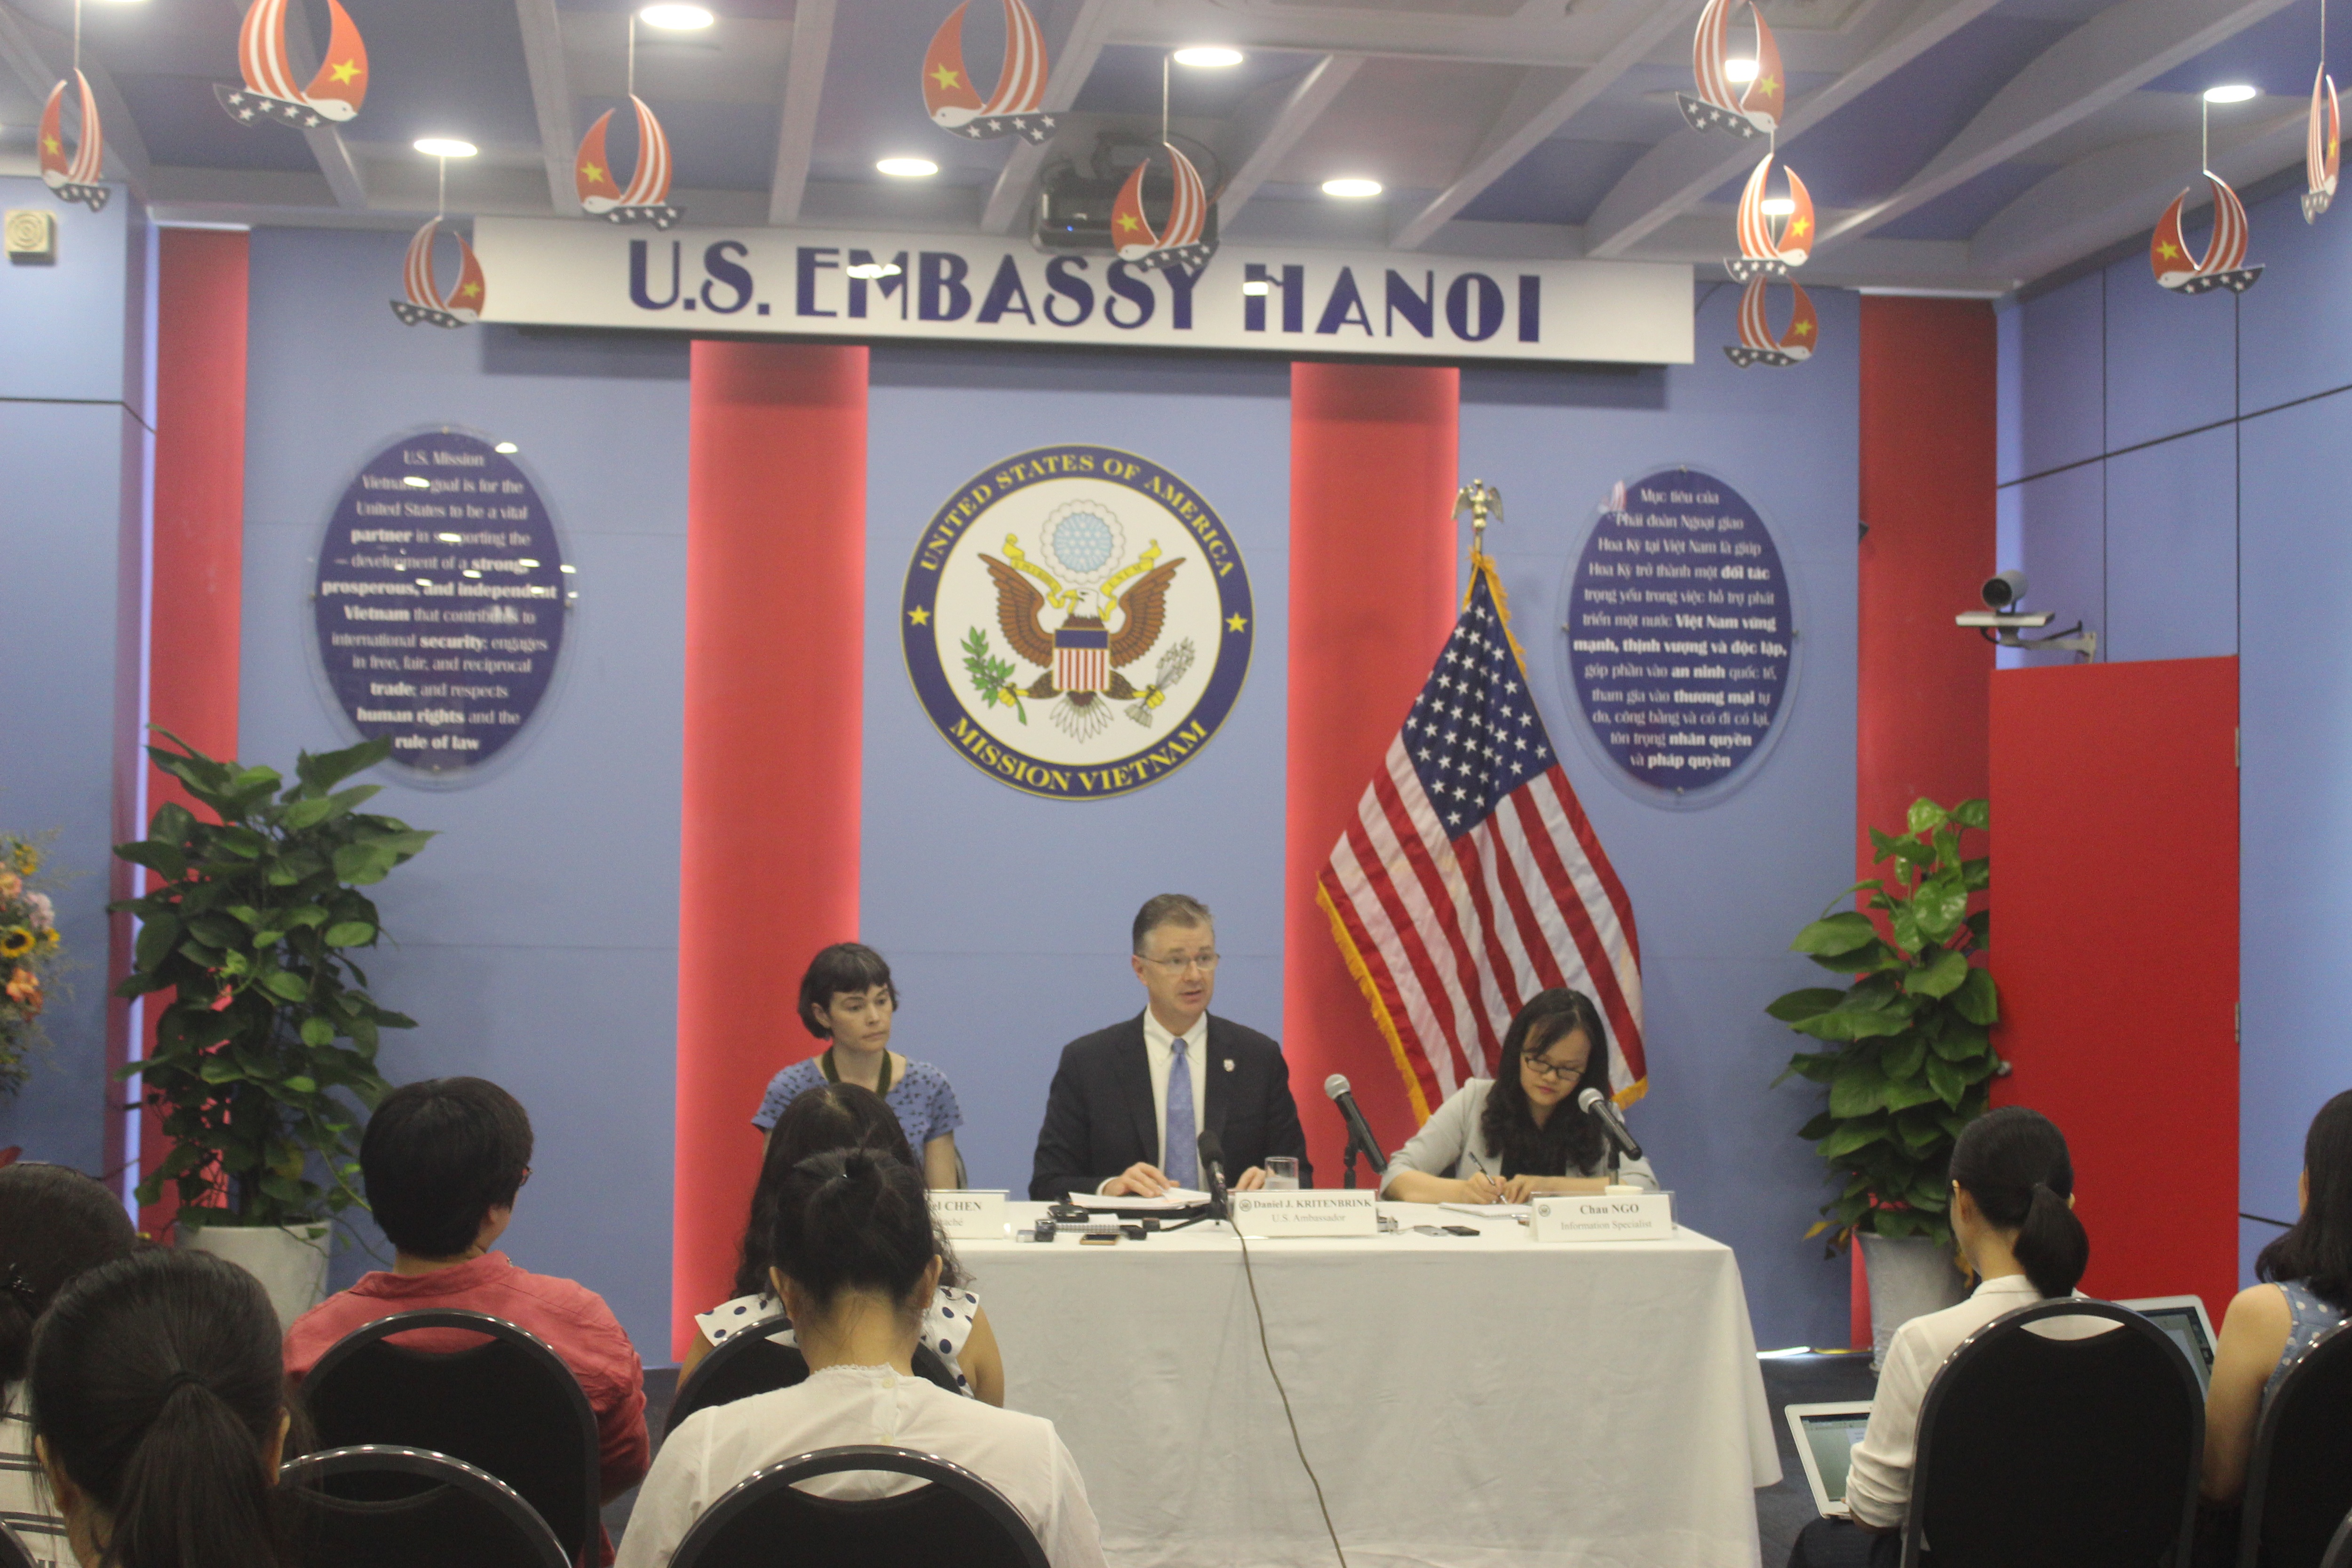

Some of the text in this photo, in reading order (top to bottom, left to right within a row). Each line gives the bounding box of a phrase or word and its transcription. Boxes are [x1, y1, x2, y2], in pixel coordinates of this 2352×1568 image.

[629, 240, 1540, 342] U.S. EMBASSY HANOI
[403, 449, 485, 467] U.S. Mission
[362, 475, 524, 494] Vietna goal is for the
[356, 500, 529, 520] United States to be a vital
[920, 484, 993, 572] UNITED
[995, 454, 1095, 488] STATES
[1103, 458, 1141, 479] OF
[1144, 475, 1234, 578] AMERICA
[351, 529, 413, 544] partner
[416, 529, 429, 542] in
[509, 532, 532, 546] the
[351, 553, 438, 570] development
[441, 556, 455, 570] of
[458, 558, 469, 570] a
[322, 581, 420, 597] prosperous,
[423, 582, 454, 596] and
[344, 605, 410, 622] Vietnam
[413, 607, 440, 623] that
[522, 612, 536, 624] to
[332, 632, 416, 648] international
[491, 638, 548, 652] engages
[352, 655, 367, 669] in
[370, 655, 400, 671] free,
[432, 656, 459, 671] and
[463, 657, 532, 674] reciprocal
[420, 683, 447, 697] and
[450, 685, 509, 700] respects
[357, 706, 519, 726] human rights and the
[394, 734, 480, 751] rule of law
[949, 716, 1208, 792] MISSION VIETNAM
[945, 1202, 982, 1211] CHEN
[1254, 1199, 1371, 1209] Daniel J. KRITENBRINK
[1580, 1203, 1639, 1214] Chau NGO
[1271, 1213, 1346, 1222] U.S. Ambassador
[1561, 1220, 1653, 1231] Information Specialist
